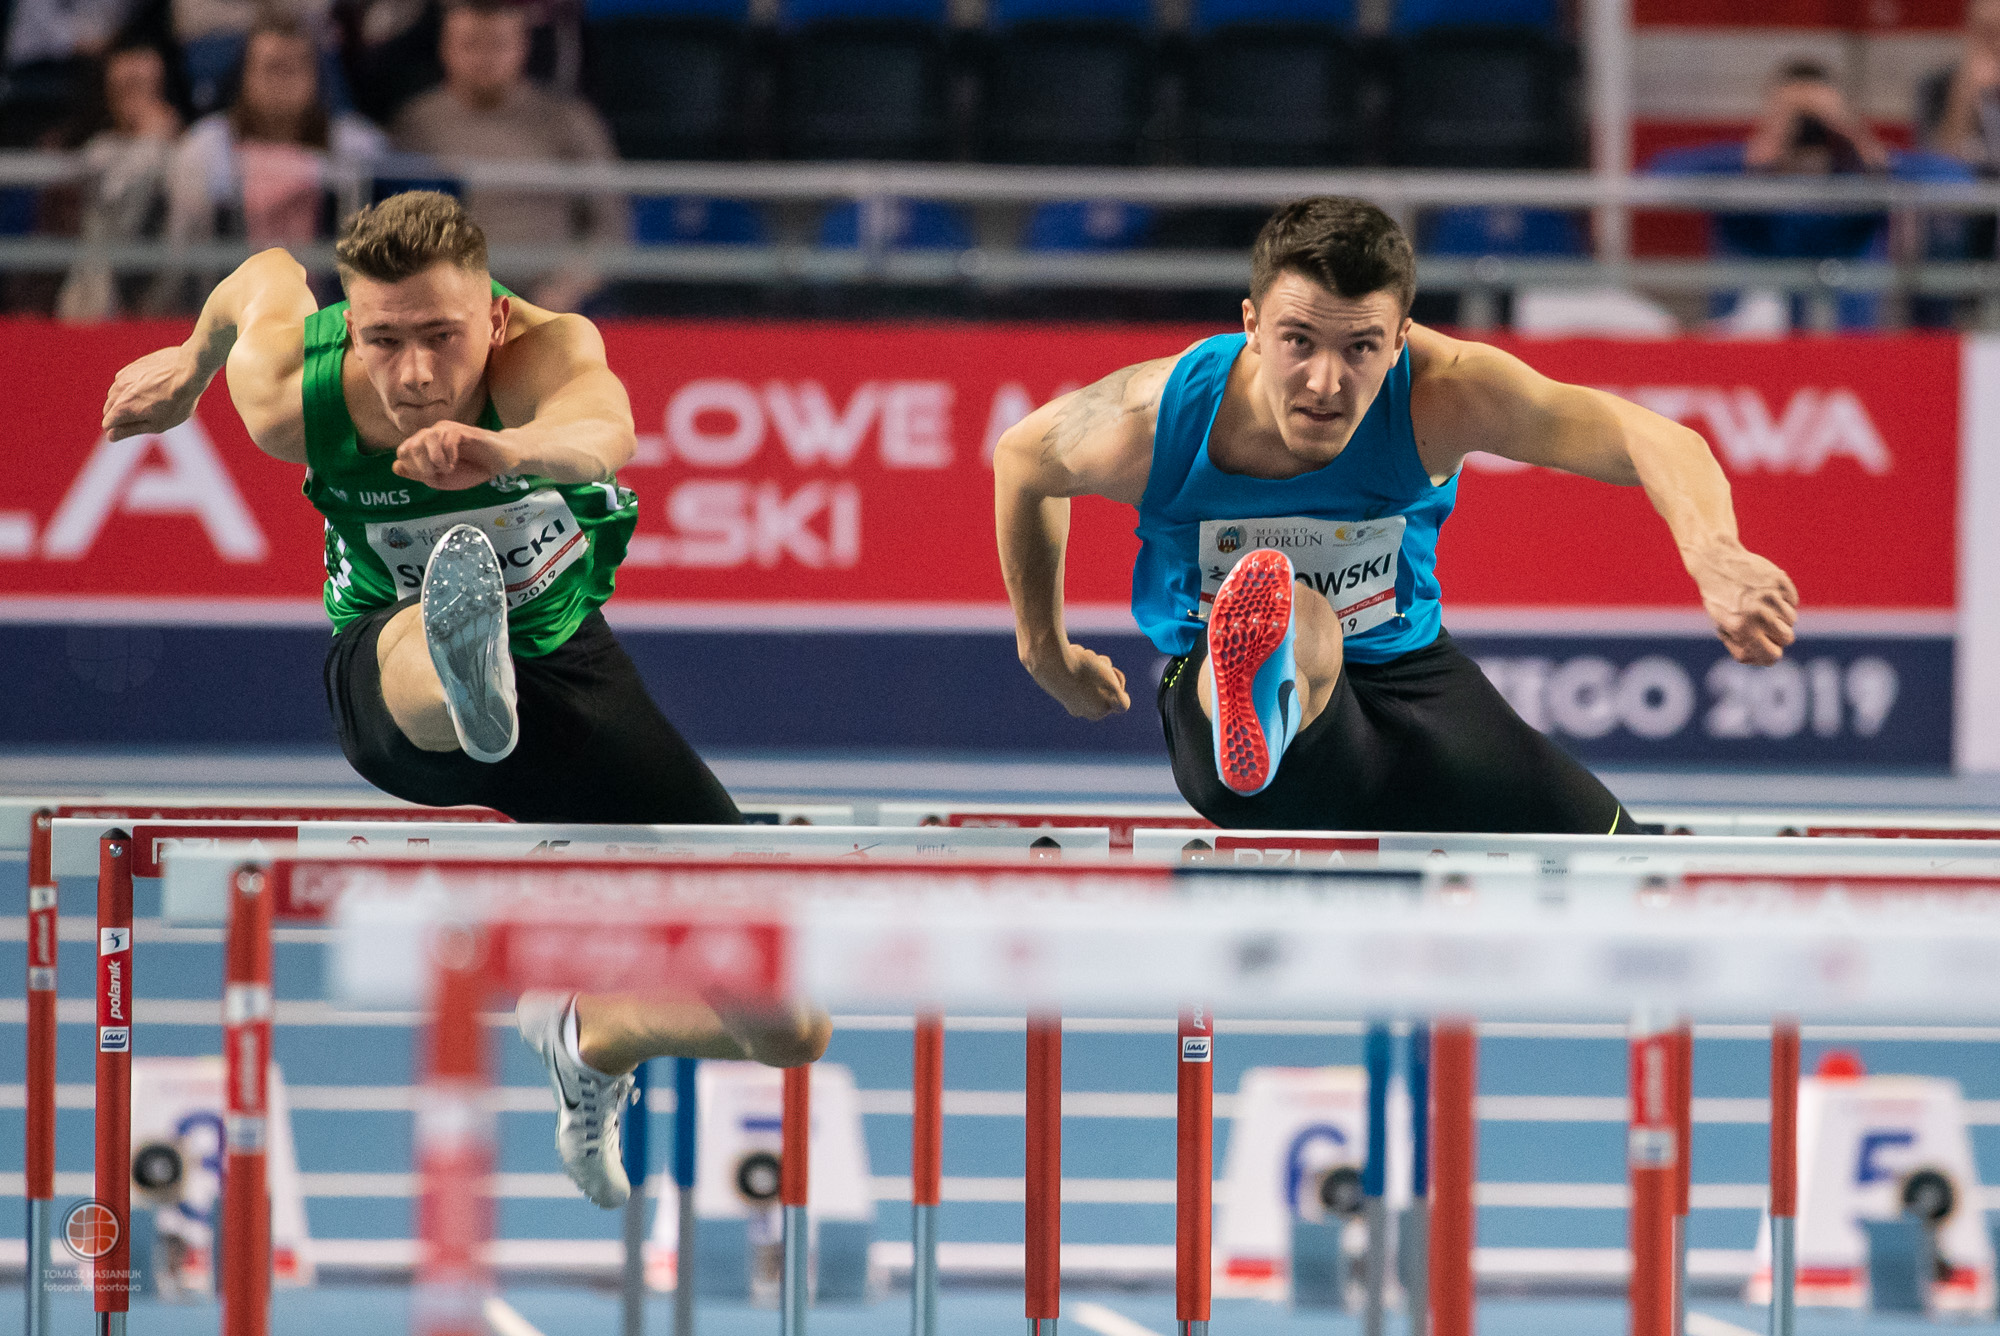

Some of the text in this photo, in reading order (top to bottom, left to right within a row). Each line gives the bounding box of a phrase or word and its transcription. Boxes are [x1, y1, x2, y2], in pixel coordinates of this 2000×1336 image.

[630, 379, 955, 468] OWE
[359, 489, 410, 506] UMCS
[620, 480, 861, 568] SKI
[1253, 530, 1323, 548] TORUŃ
[1255, 527, 1308, 536] MIASTO
[517, 569, 556, 603] 2019
[1705, 655, 1898, 740] 2019
[107, 960, 124, 1020] polanik
[104, 1033, 126, 1041] IAAF
